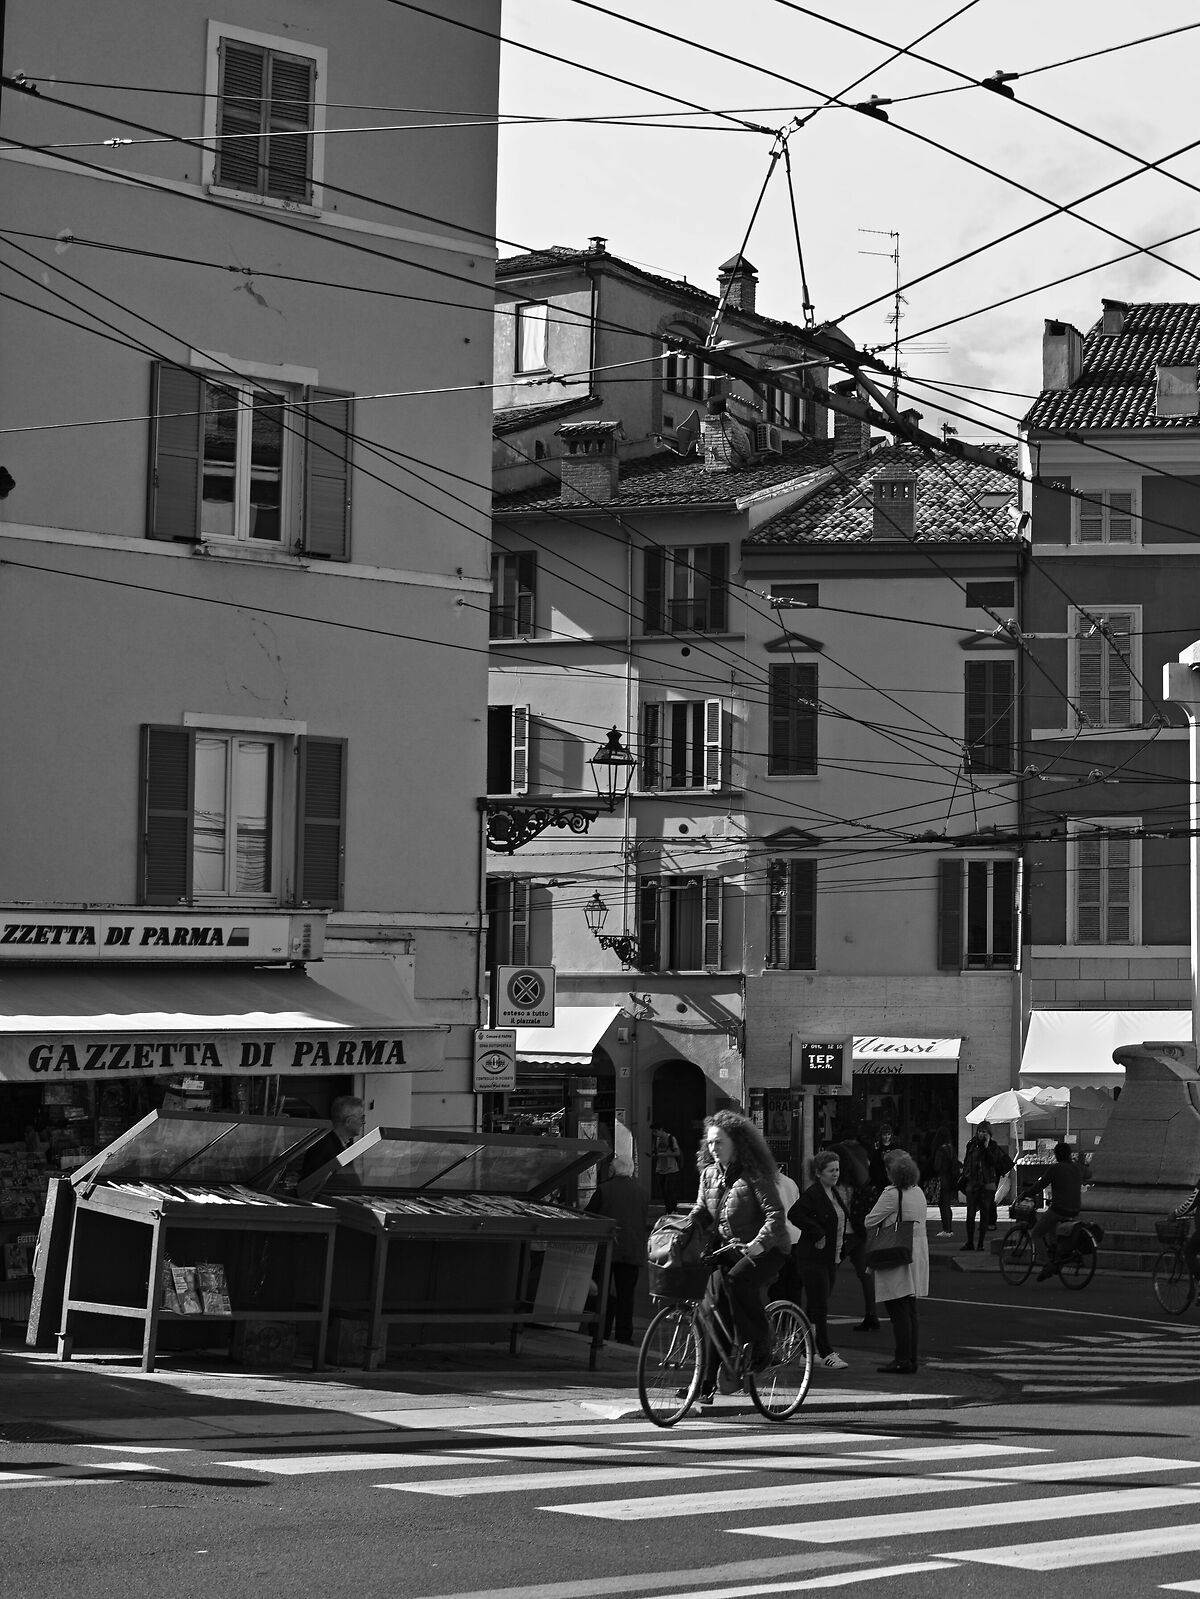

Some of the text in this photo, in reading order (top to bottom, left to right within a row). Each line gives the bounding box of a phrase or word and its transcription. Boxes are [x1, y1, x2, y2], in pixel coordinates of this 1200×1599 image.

[0, 924, 225, 946] ZZETTA DI PARMA
[28, 1039, 407, 1073] GAZZETTA DI PARMA
[808, 1054, 835, 1064] TEP
[853, 1060, 904, 1074] Mussi
